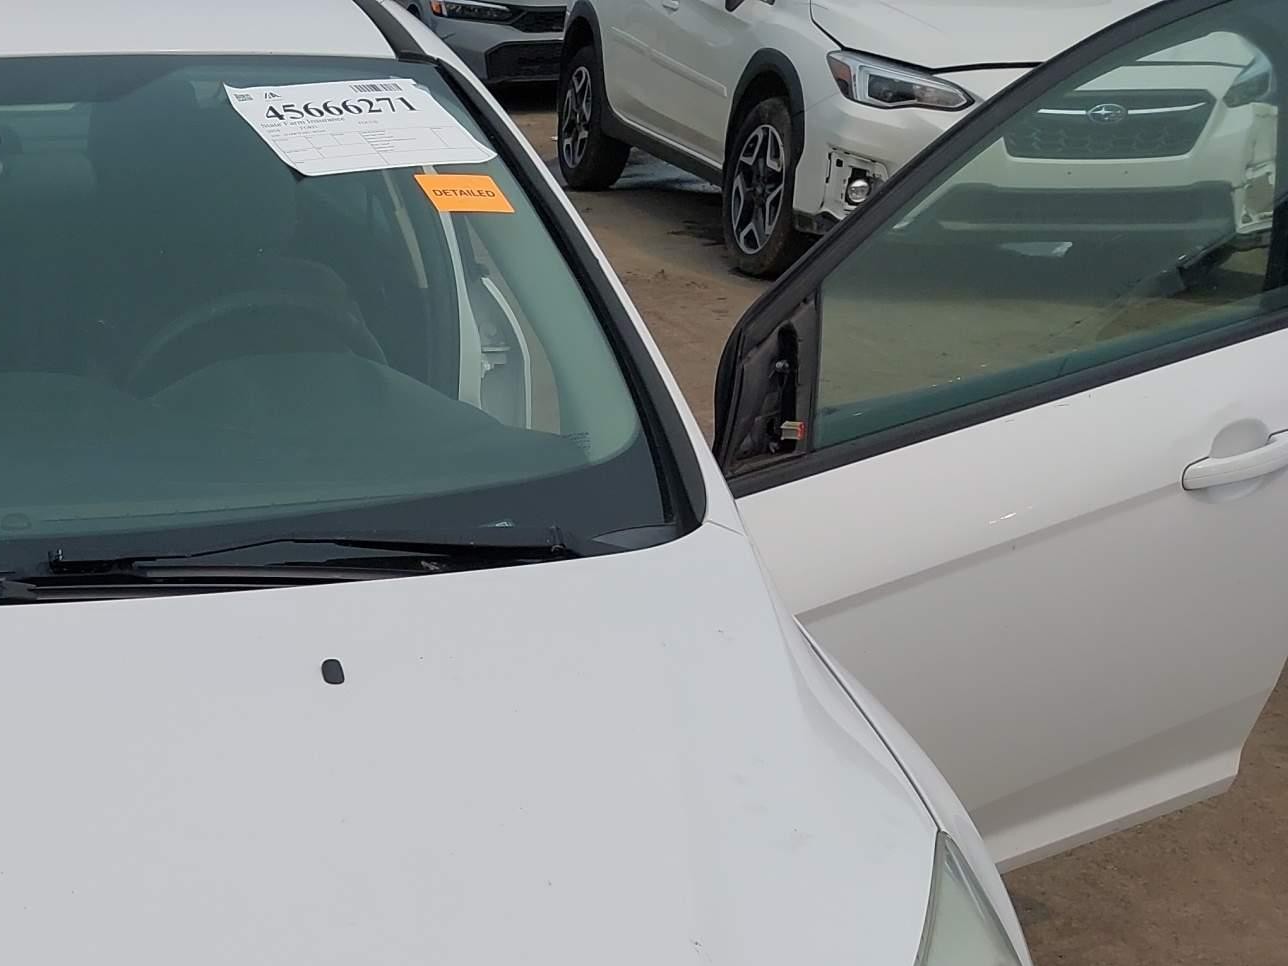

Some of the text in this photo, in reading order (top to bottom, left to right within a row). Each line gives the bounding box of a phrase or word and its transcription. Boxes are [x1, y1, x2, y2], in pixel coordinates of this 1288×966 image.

[265, 97, 417, 121] 45666271
[283, 119, 306, 127] Farm
[432, 189, 496, 198] DETAILED
